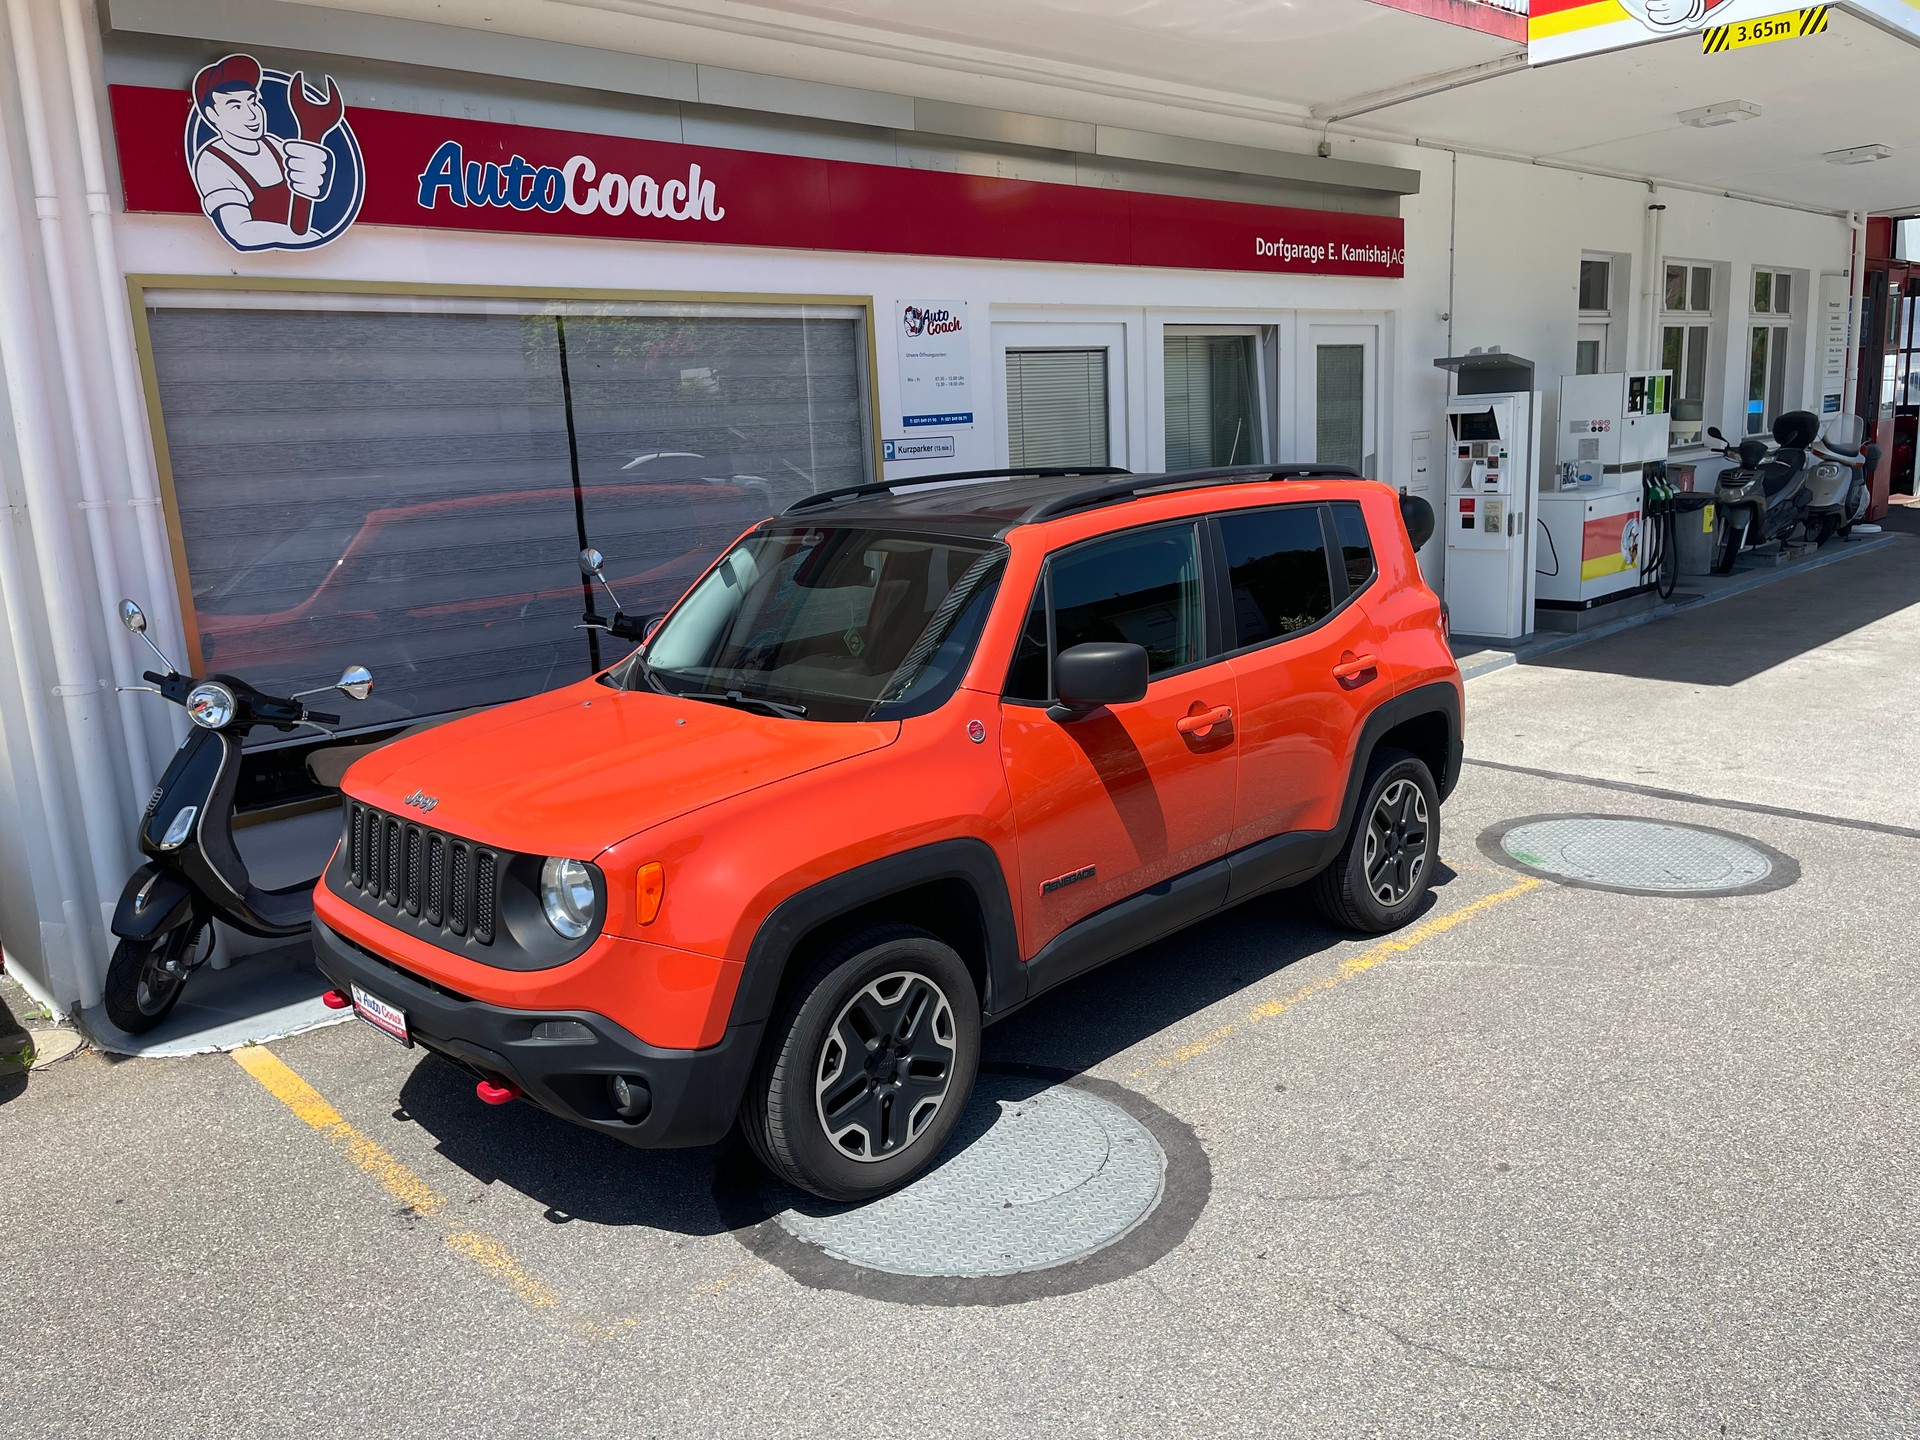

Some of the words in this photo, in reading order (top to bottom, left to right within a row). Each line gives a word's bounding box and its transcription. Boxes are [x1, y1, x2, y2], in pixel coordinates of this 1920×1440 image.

[1737, 20, 1791, 42] 3.65m
[1255, 237, 1325, 263] Dorfgarage
[1328, 242, 1338, 260] E.
[922, 309, 949, 325] Auto
[927, 316, 962, 336] Coach
[897, 445, 934, 455] Kurzparker
[404, 788, 439, 814] Jeep
